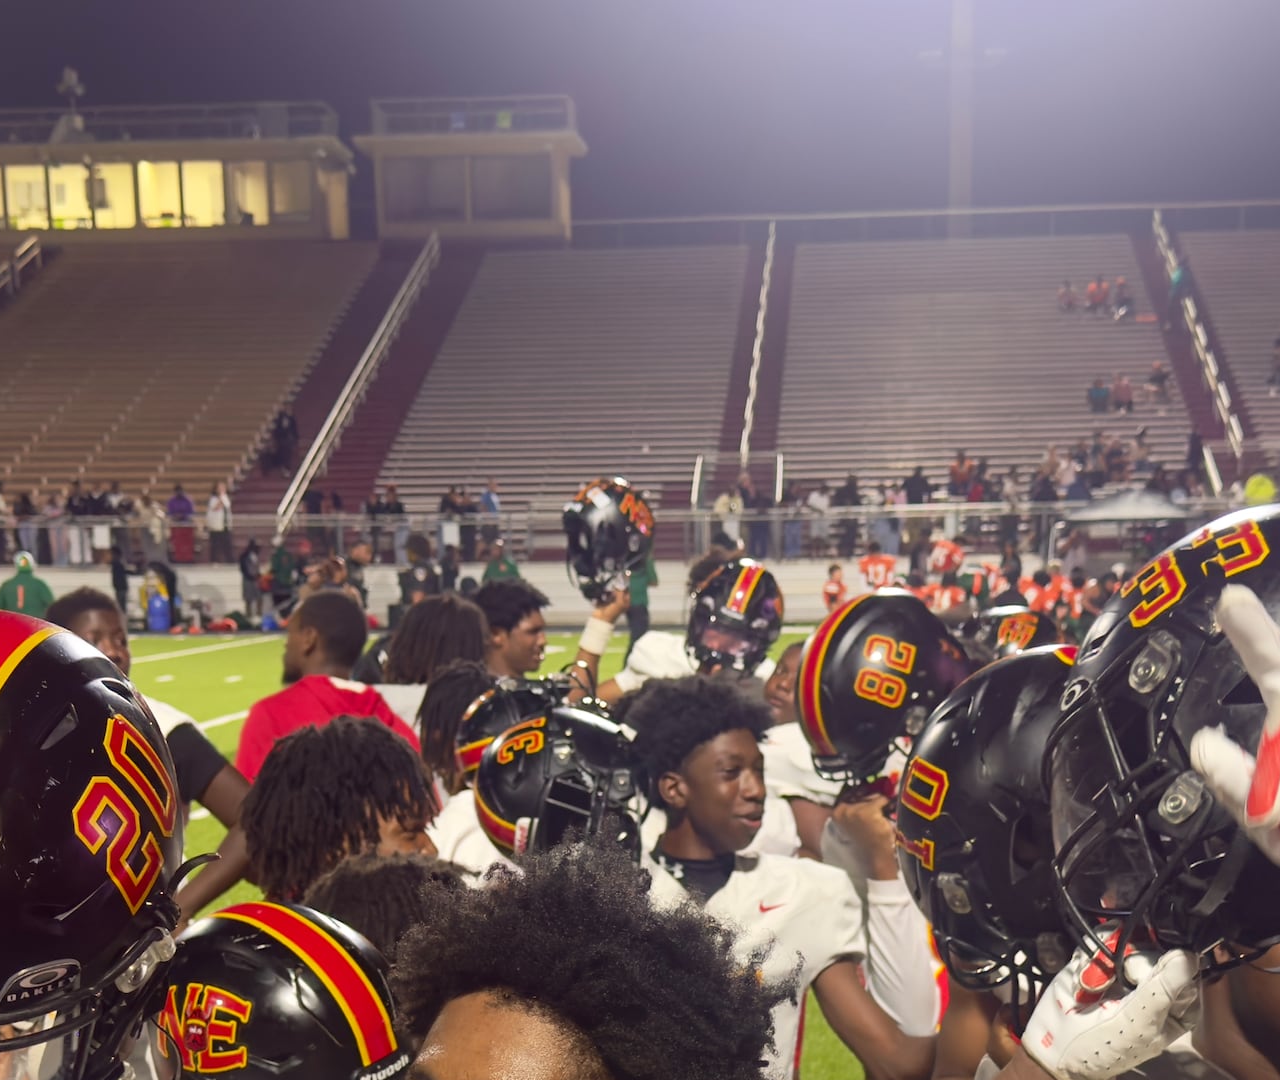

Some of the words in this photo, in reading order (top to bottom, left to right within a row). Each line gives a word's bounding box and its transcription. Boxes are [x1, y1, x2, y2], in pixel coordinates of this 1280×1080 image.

[854, 634, 917, 708] 82
[72, 713, 177, 916] 20
[6, 974, 77, 1003] OAKLEY
[157, 982, 252, 1074] NE
